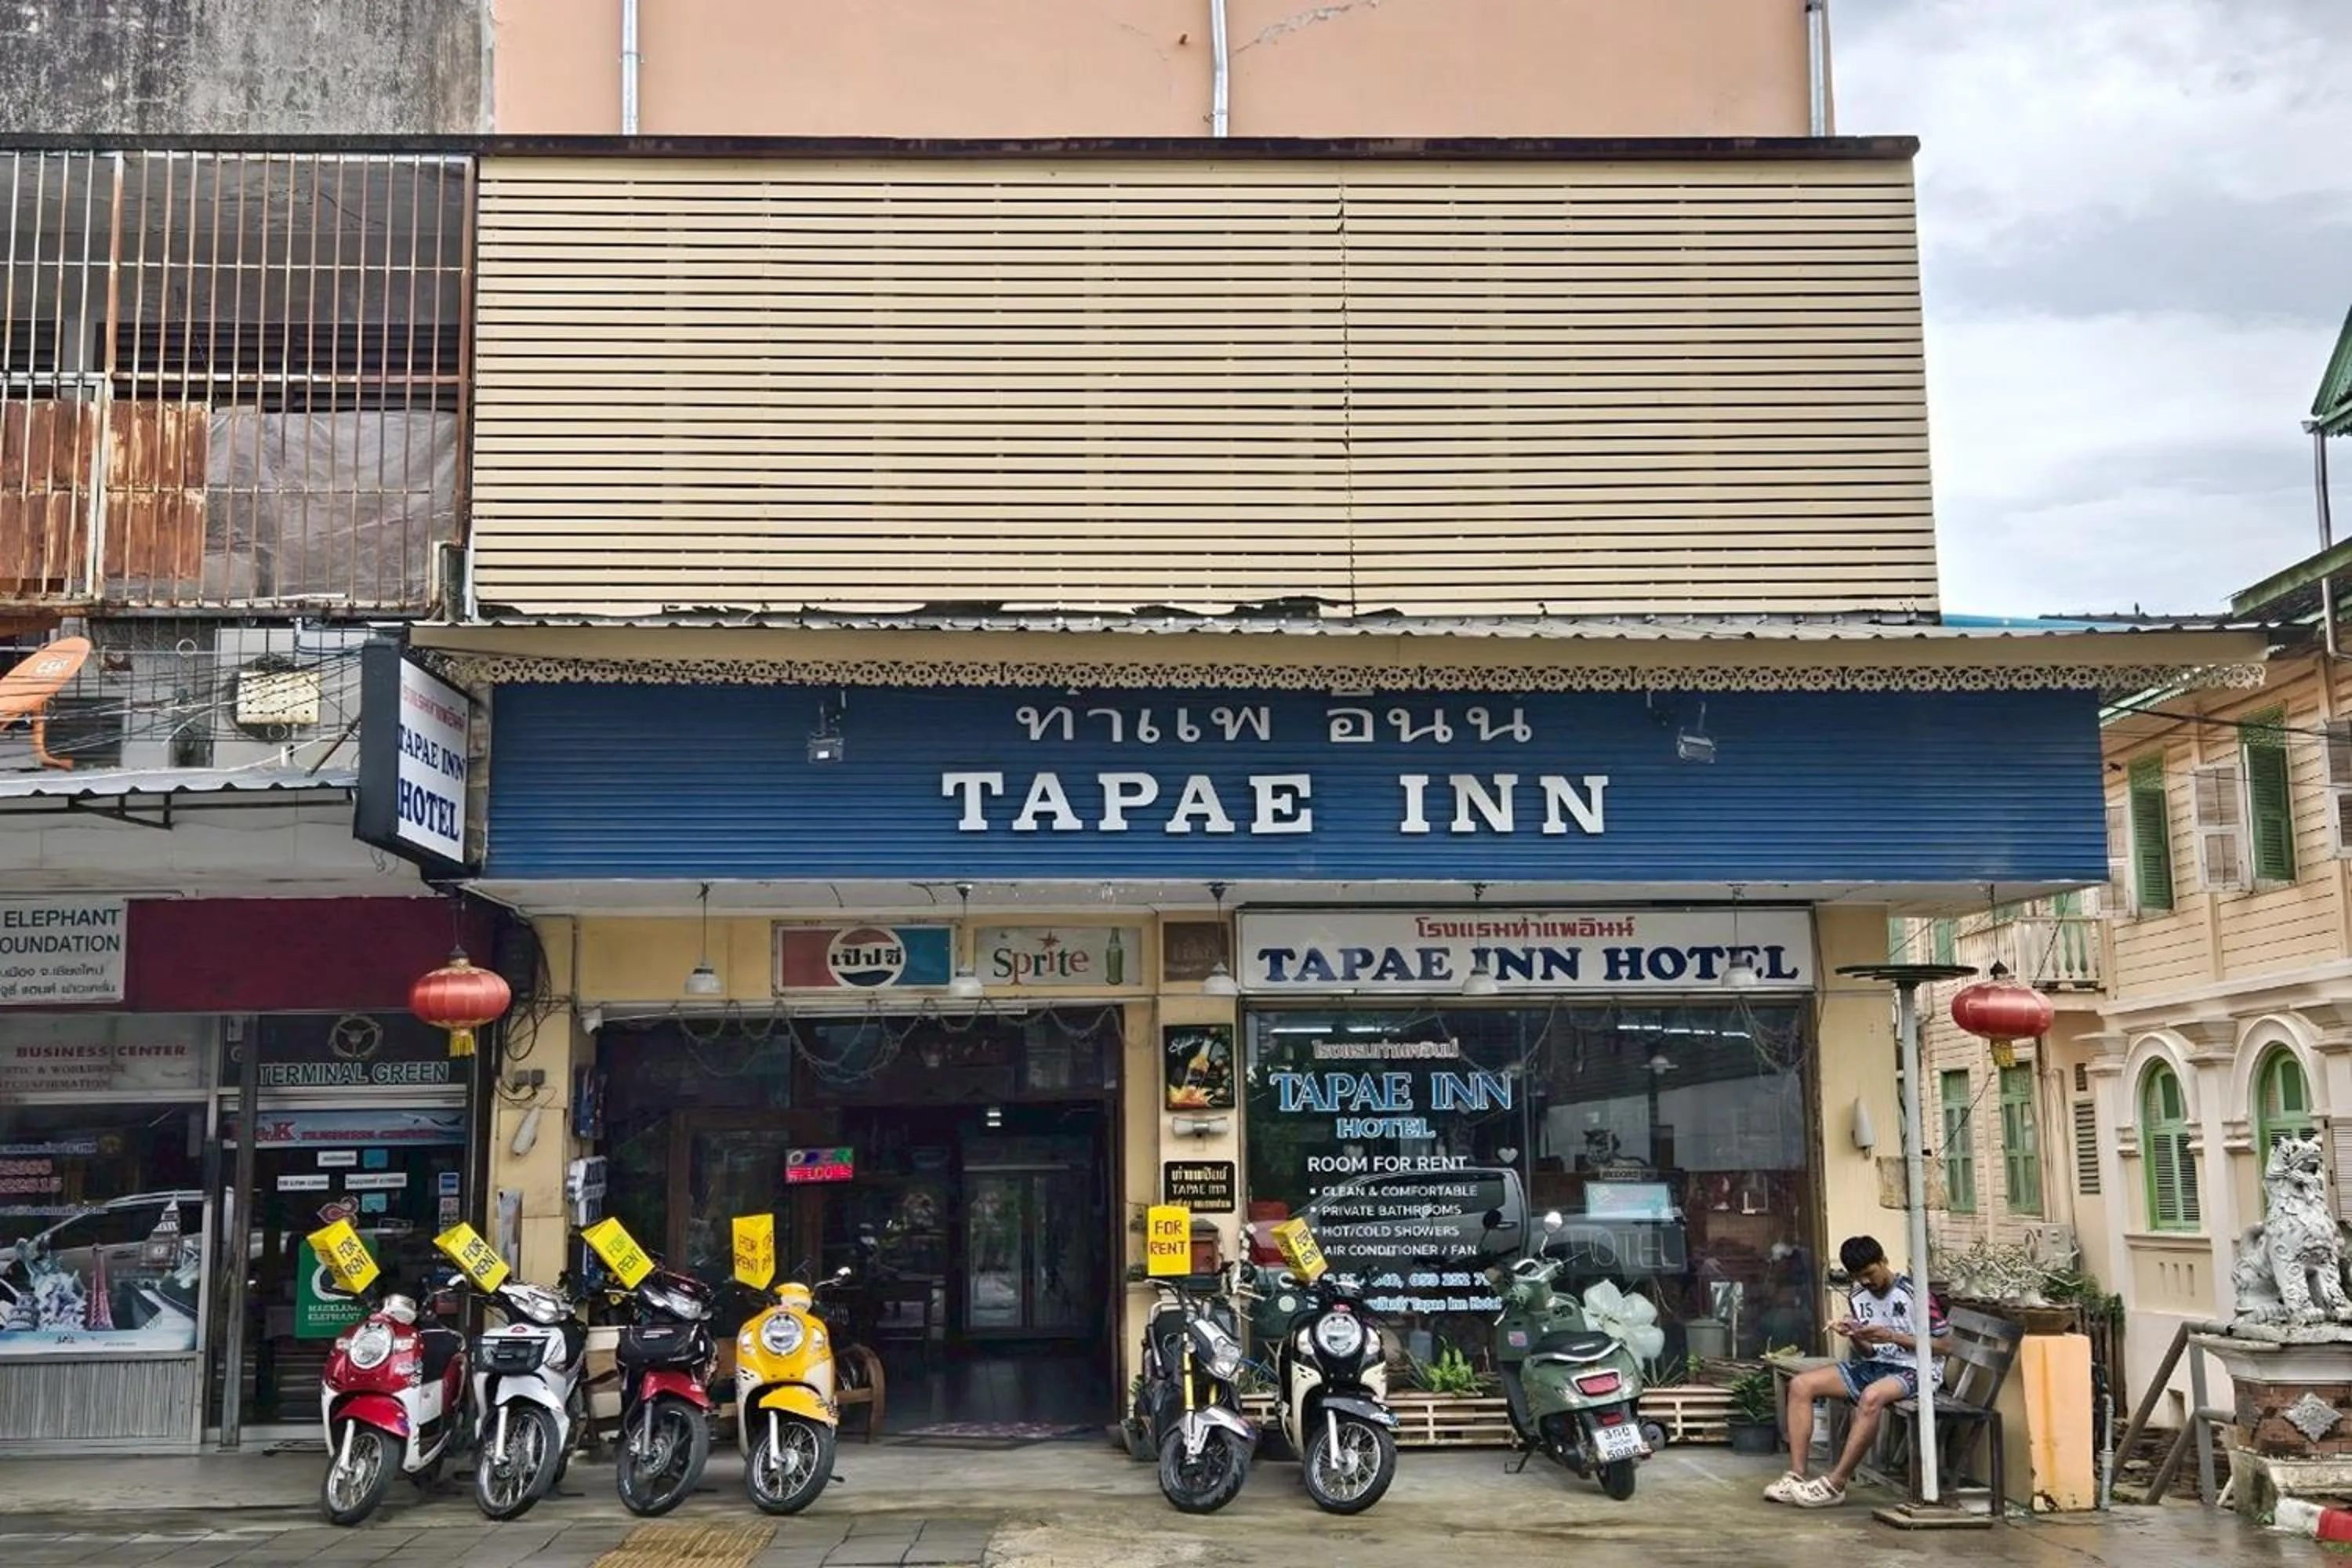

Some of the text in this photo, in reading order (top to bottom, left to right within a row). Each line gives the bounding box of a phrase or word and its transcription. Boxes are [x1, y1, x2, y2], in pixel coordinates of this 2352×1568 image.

[397, 722, 466, 782] TAPAE INN
[397, 778, 460, 842] HOTEL
[942, 772, 1609, 835] TAPAE INN
[4, 909, 121, 927] ELEPHANT
[993, 942, 1089, 985] Sprite
[1258, 946, 1799, 982] TAPAE INN HOTEL
[16, 1044, 187, 1058] BUSINESS CENTER
[260, 1062, 450, 1086] TERMINAL GREEN
[1269, 1071, 1513, 1112] TAPAE INN
[1336, 1116, 1436, 1139] HOTEL
[1308, 1156, 1468, 1172] ROOM FOR RENT
[1322, 1185, 1478, 1197] CLEAN & COMFORTABLE
[1323, 1203, 1463, 1216] PRIVATE BATHROOMS
[1155, 1220, 1184, 1236] FOR
[1323, 1225, 1461, 1237] HOT/COLD SHOWERS
[336, 1236, 358, 1258] FOR
[463, 1236, 486, 1261] FOR
[605, 1233, 626, 1258] FOR
[1149, 1241, 1186, 1256] RENT
[1324, 1244, 1346, 1255] AIR
[1348, 1243, 1438, 1255] CONDITIONER
[1451, 1243, 1477, 1255] FAN
[344, 1251, 372, 1277] RENT
[472, 1250, 500, 1279] RENT
[616, 1247, 644, 1276] RENT
[1410, 1296, 1446, 1314] Tapae
[1447, 1296, 1468, 1310] Inn
[1469, 1296, 1503, 1311] Hotel
[1860, 1302, 1873, 1318] 15
